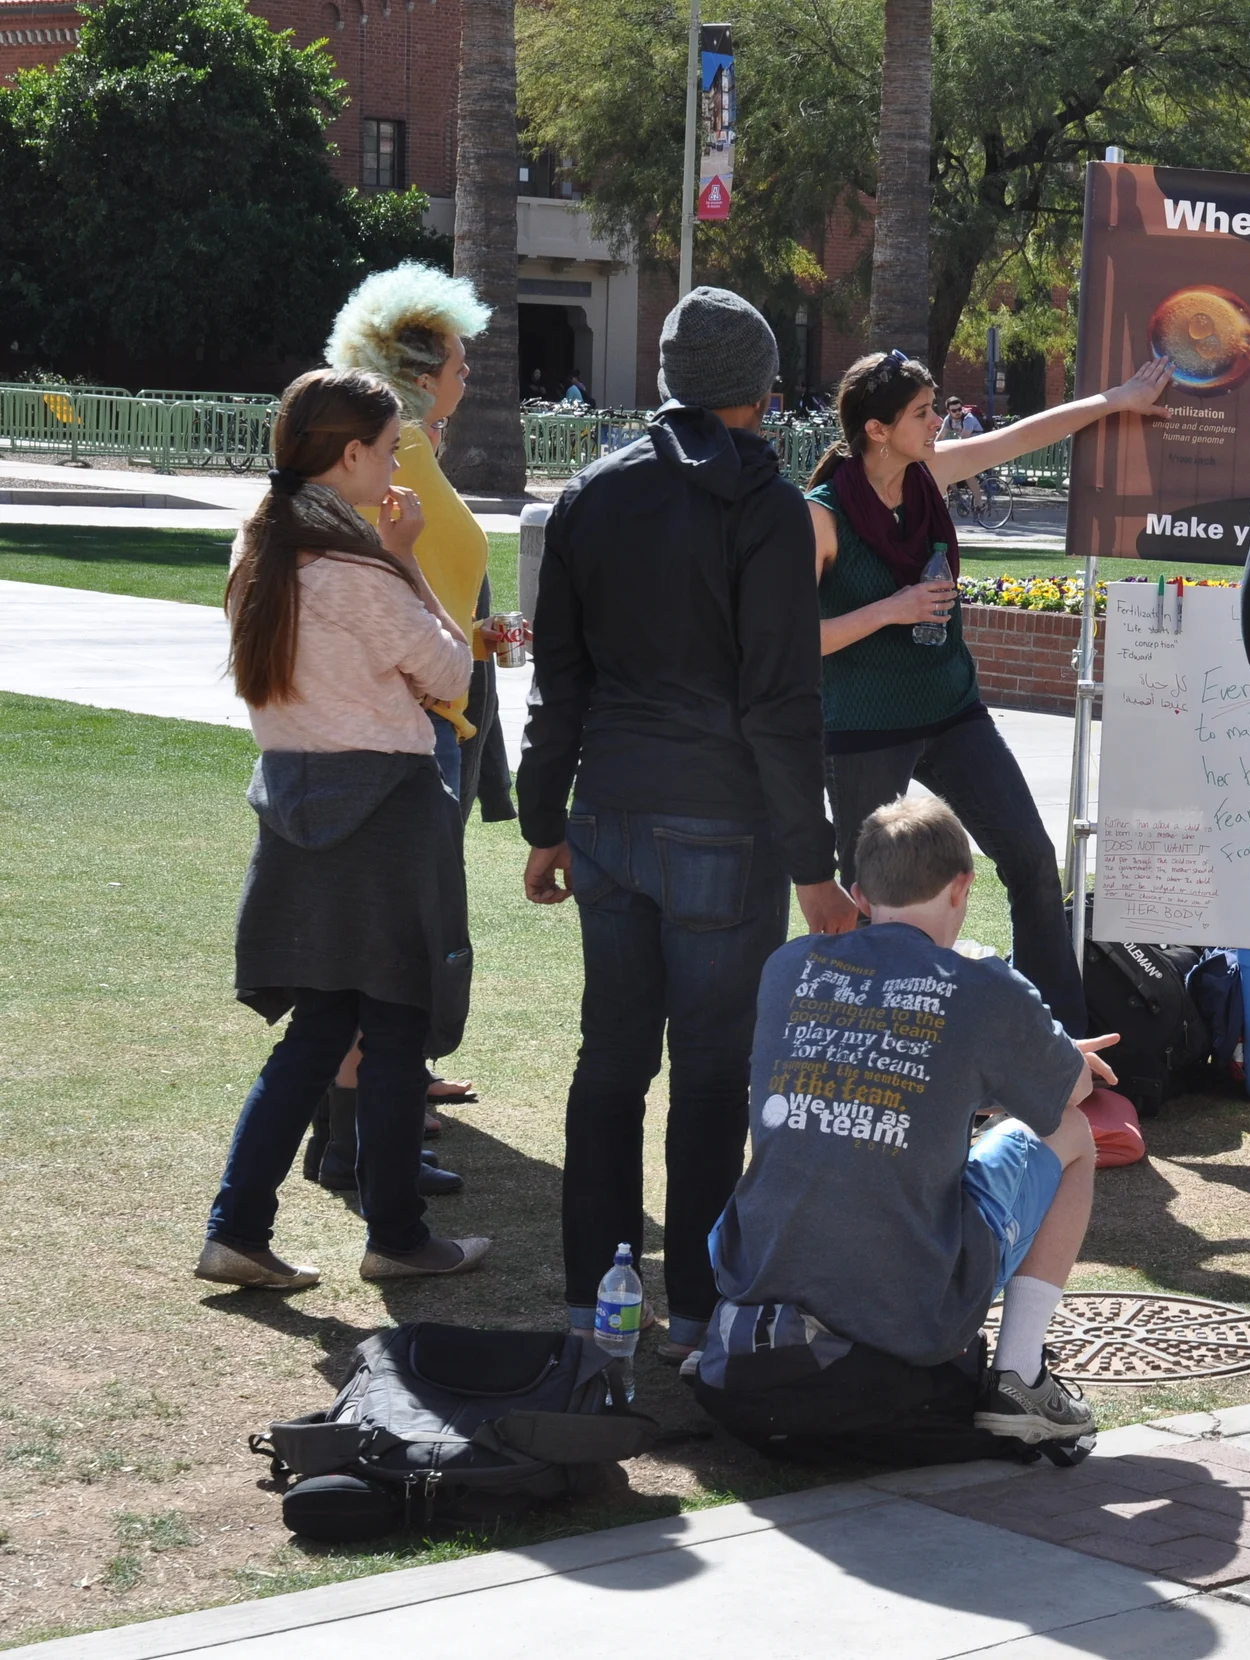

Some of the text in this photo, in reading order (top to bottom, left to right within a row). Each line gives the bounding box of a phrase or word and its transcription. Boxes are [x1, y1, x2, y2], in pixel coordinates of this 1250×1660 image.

[1152, 420, 1237, 435] unique and complete
[1162, 432, 1225, 445] human genome
[1146, 513, 1224, 540] Make
[1116, 599, 1172, 622] Fertilizatin
[1194, 713, 1216, 743] to
[1202, 755, 1233, 788] her
[1101, 839, 1134, 853] DOES
[1137, 840, 1162, 852] NOT
[1163, 842, 1194, 854] WANT
[1126, 902, 1204, 922] HER BODY
[799, 960, 958, 998] I am a member
[808, 952, 877, 977] THE PROMISE
[795, 977, 946, 1016] of the team.
[789, 1010, 942, 1044] good of the team.
[799, 997, 886, 1019] contribute
[891, 1008, 910, 1022] to
[915, 1010, 946, 1030] the
[782, 1020, 934, 1058] I play my best
[772, 1059, 926, 1094] I support the members
[790, 1038, 932, 1082] for the team.
[768, 1070, 908, 1112] of the team.
[789, 1092, 911, 1130] We win as
[787, 1108, 909, 1150] a team.
